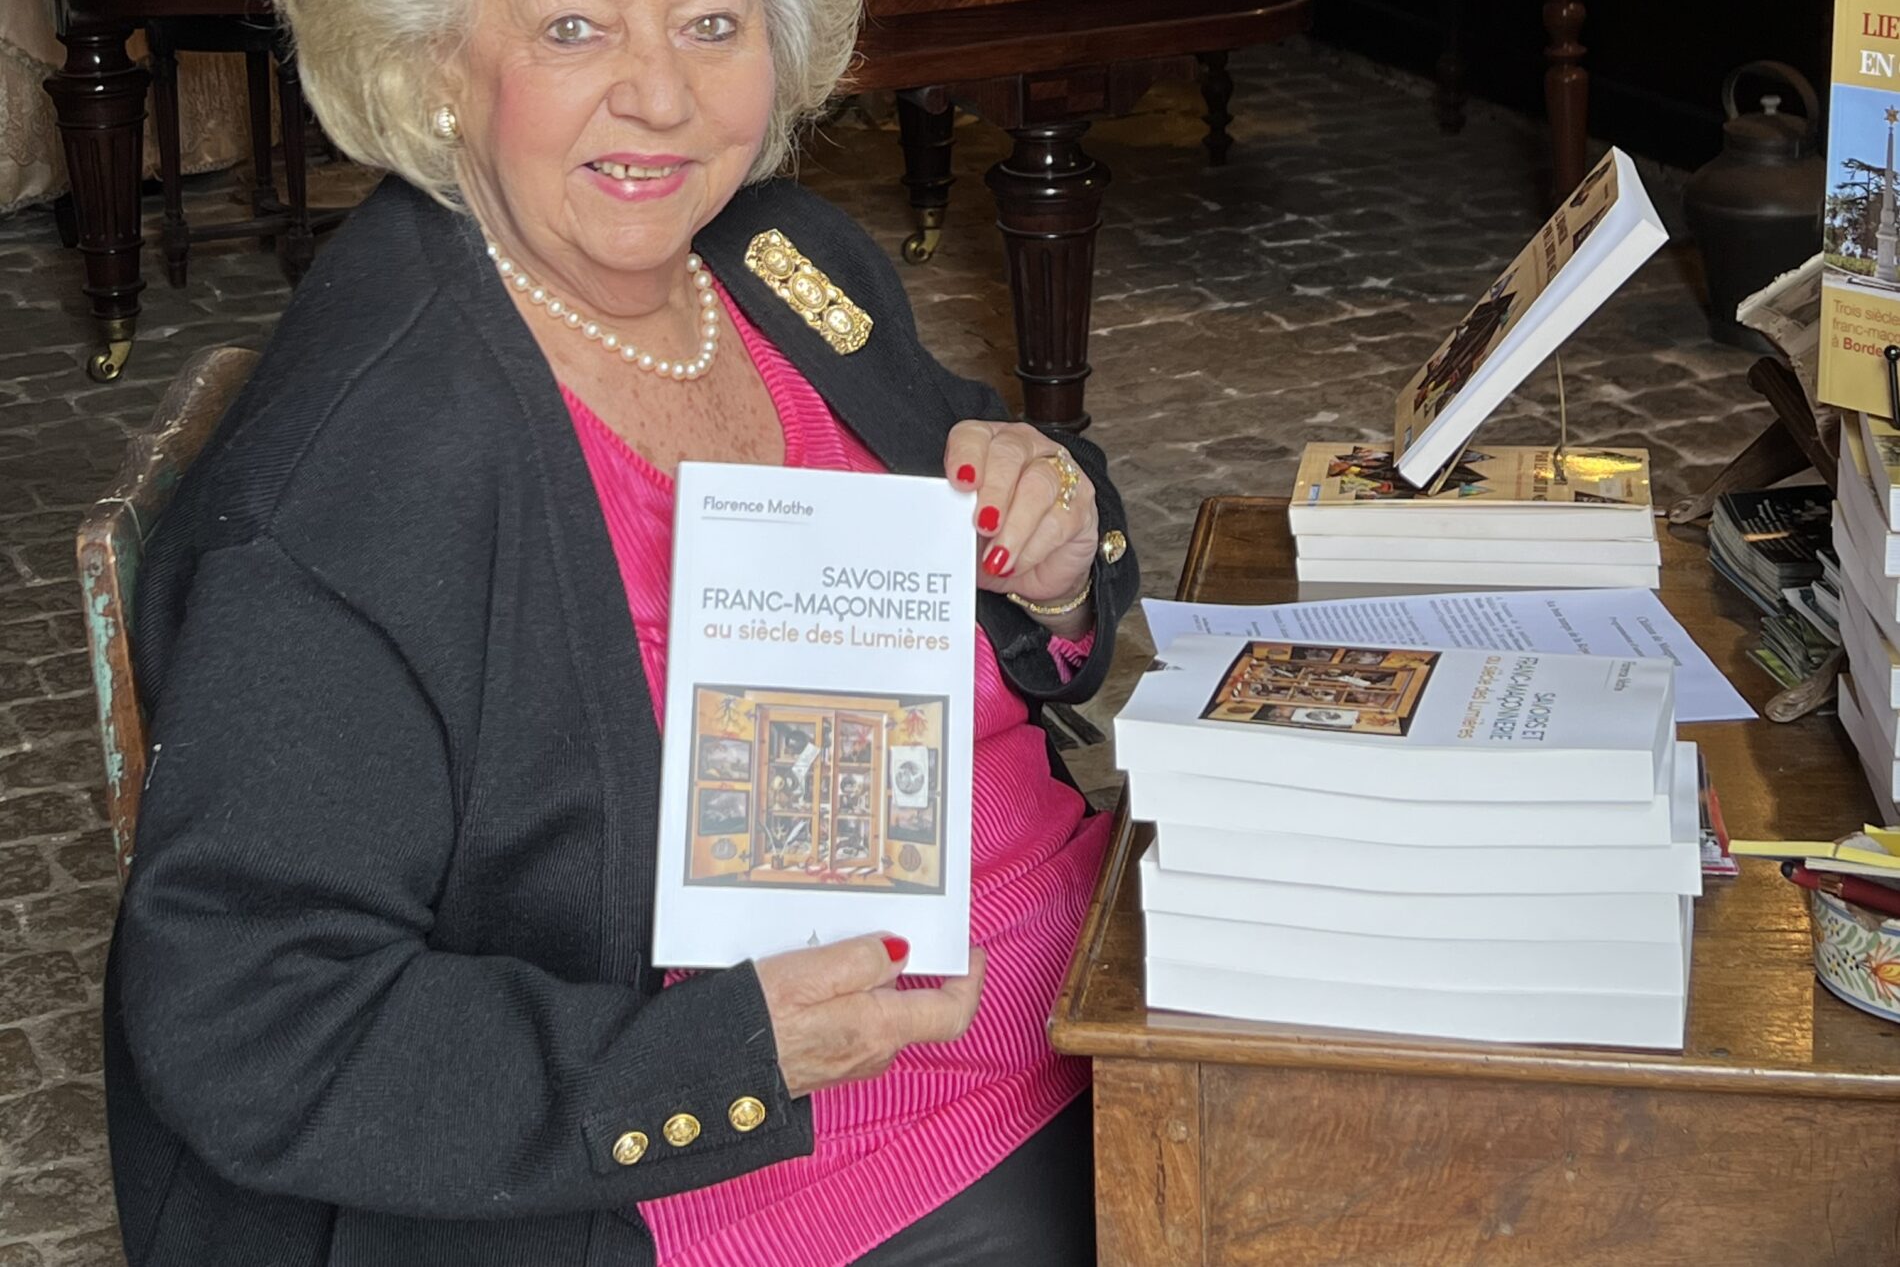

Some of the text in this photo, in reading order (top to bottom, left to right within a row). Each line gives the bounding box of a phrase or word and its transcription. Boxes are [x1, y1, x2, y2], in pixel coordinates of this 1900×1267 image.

[1861, 12, 1900, 40] LIE
[1858, 49, 1896, 78] EN
[1833, 298, 1862, 318] Trois
[1843, 337, 1883, 357] Borde
[703, 495, 814, 517] Florence Mothe
[822, 566, 952, 594] SAVOIRS ET
[702, 587, 950, 622] FRANC-MAÇONNERIE
[703, 619, 950, 651] au siècle des Lumières
[1471, 686, 1496, 701] des
[1456, 700, 1491, 740] Lumières
[1521, 692, 1556, 741] SAVOIRS ET
